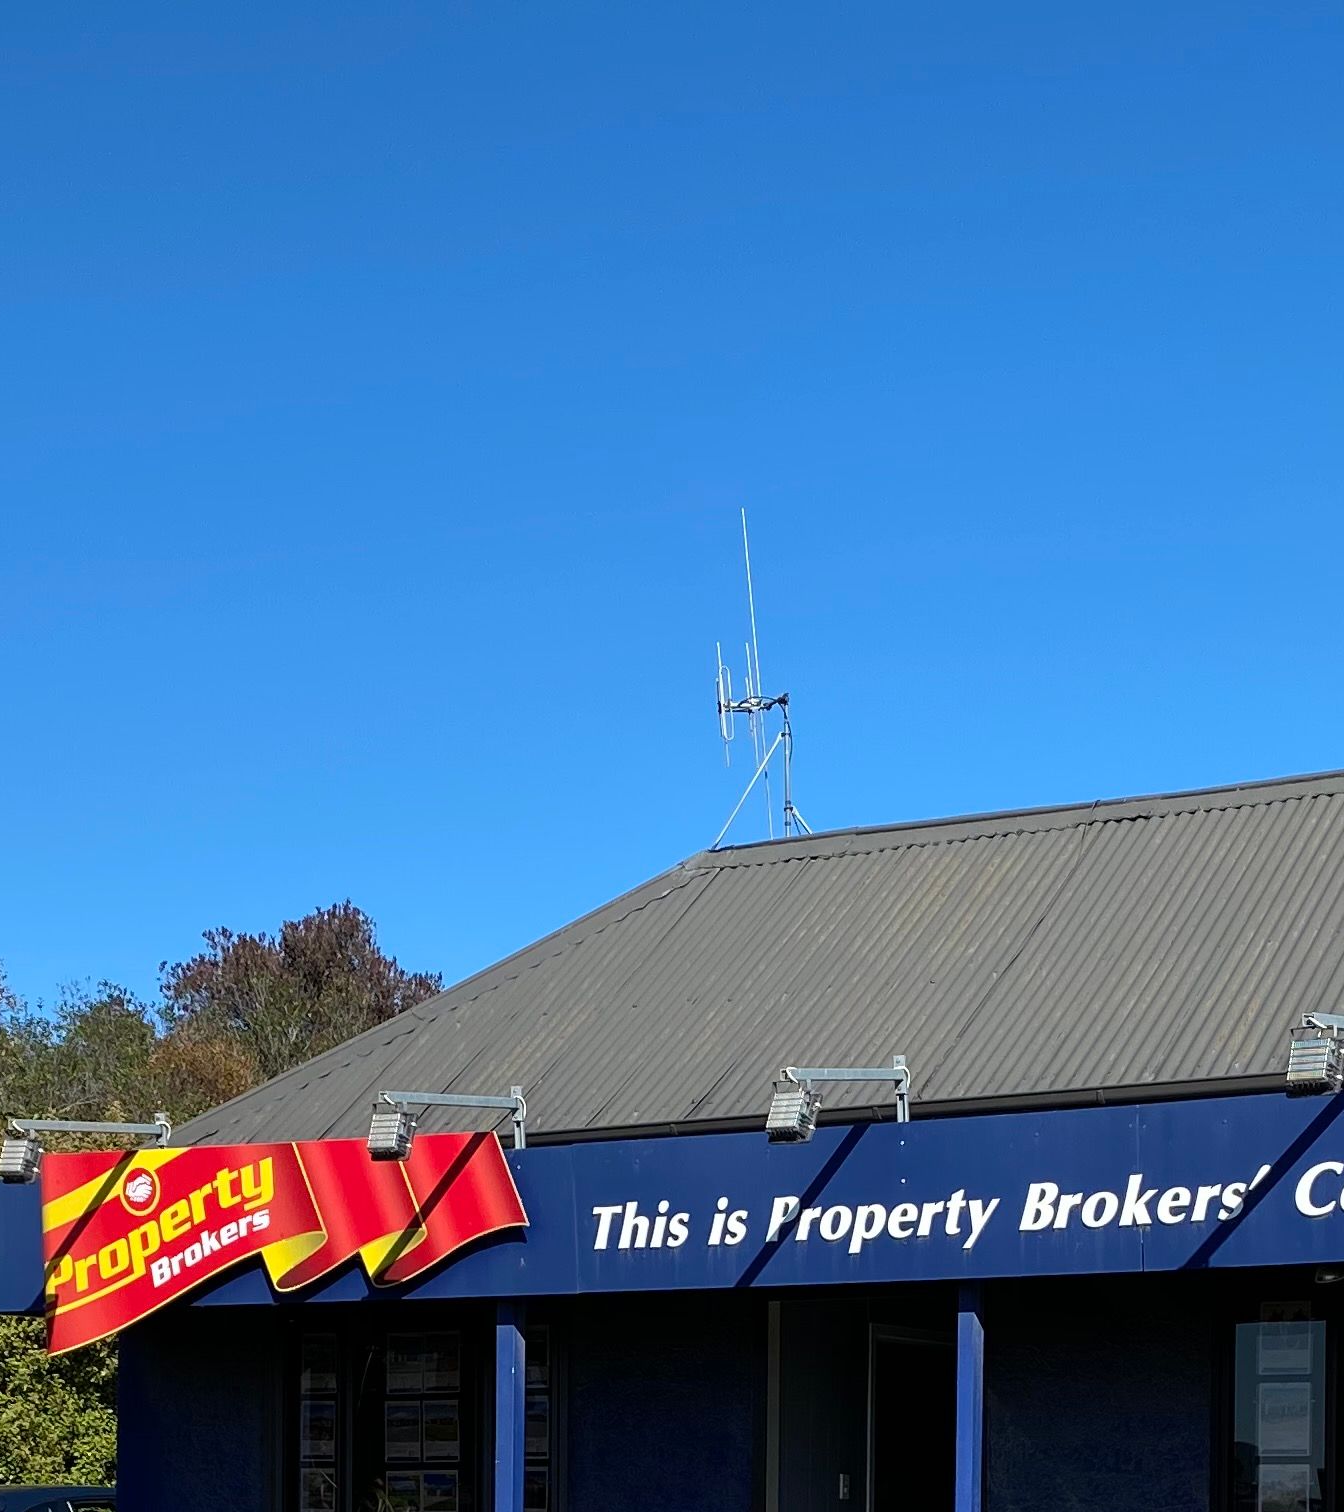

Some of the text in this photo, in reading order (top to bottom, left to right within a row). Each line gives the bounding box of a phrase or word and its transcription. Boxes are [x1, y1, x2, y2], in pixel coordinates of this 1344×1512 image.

[45, 1156, 274, 1295] Property
[150, 1208, 271, 1288] Brokers
[592, 1200, 690, 1250] This
[707, 1196, 748, 1247] is
[765, 1189, 1001, 1254] Property
[1018, 1164, 1271, 1232] Brokers'
